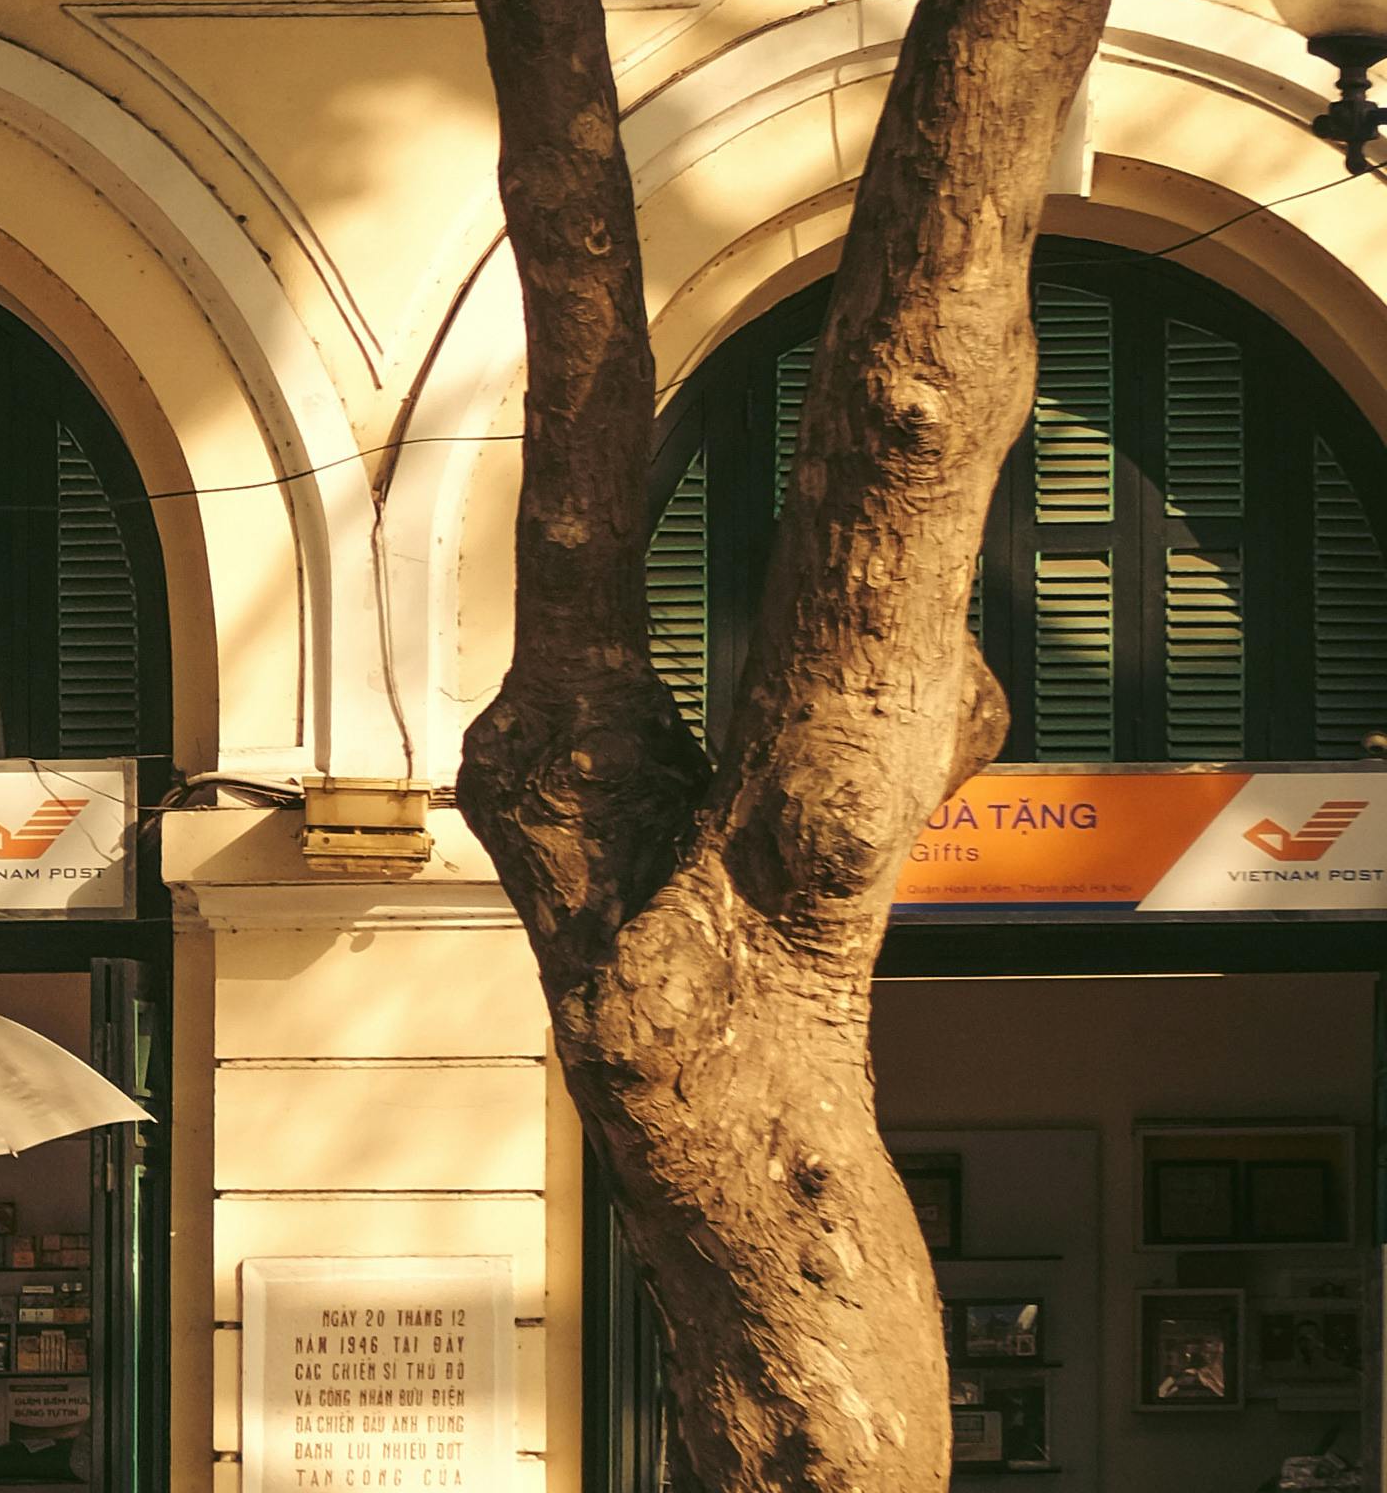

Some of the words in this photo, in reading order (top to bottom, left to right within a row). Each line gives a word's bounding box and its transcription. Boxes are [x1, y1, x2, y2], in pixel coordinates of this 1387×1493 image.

[927, 798, 979, 830] UÀ
[987, 797, 1098, 835] TẶNG
[909, 843, 980, 862] Gifts
[49, 868, 106, 880] POST
[1228, 870, 1319, 882] VIETNAM
[1329, 869, 1384, 881] POST
[365, 1309, 386, 1327] 20
[452, 1309, 466, 1327] 12
[340, 1335, 378, 1354] 1946
